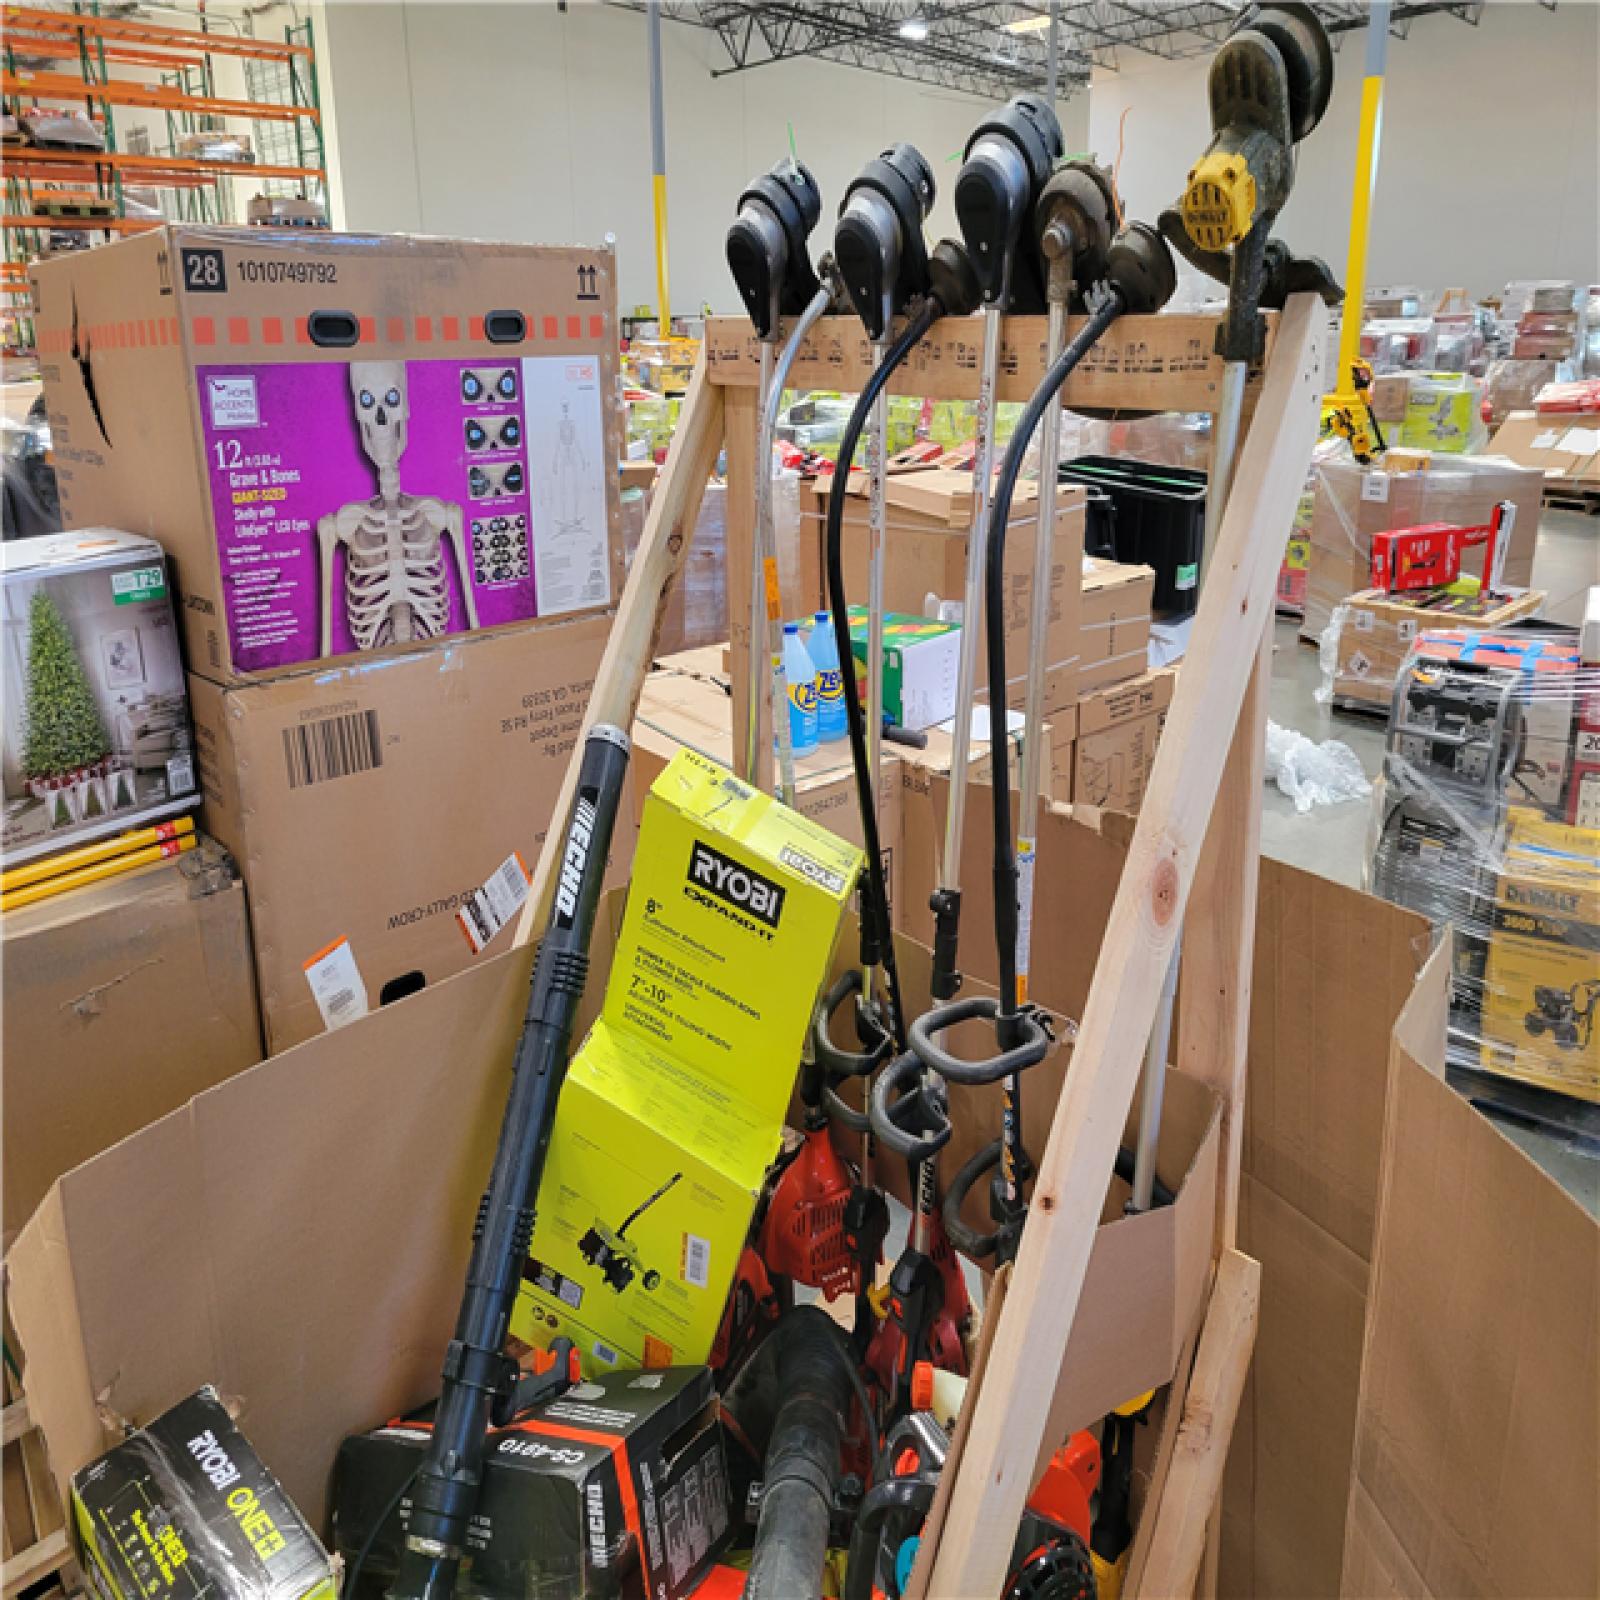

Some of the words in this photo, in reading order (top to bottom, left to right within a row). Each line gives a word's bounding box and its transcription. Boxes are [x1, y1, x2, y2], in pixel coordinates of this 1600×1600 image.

[187, 254, 221, 286] 28
[237, 260, 338, 284] 1010749792
[213, 439, 243, 470] 12
[694, 850, 778, 919] RYOBI
[187, 1429, 241, 1491] RYOBI
